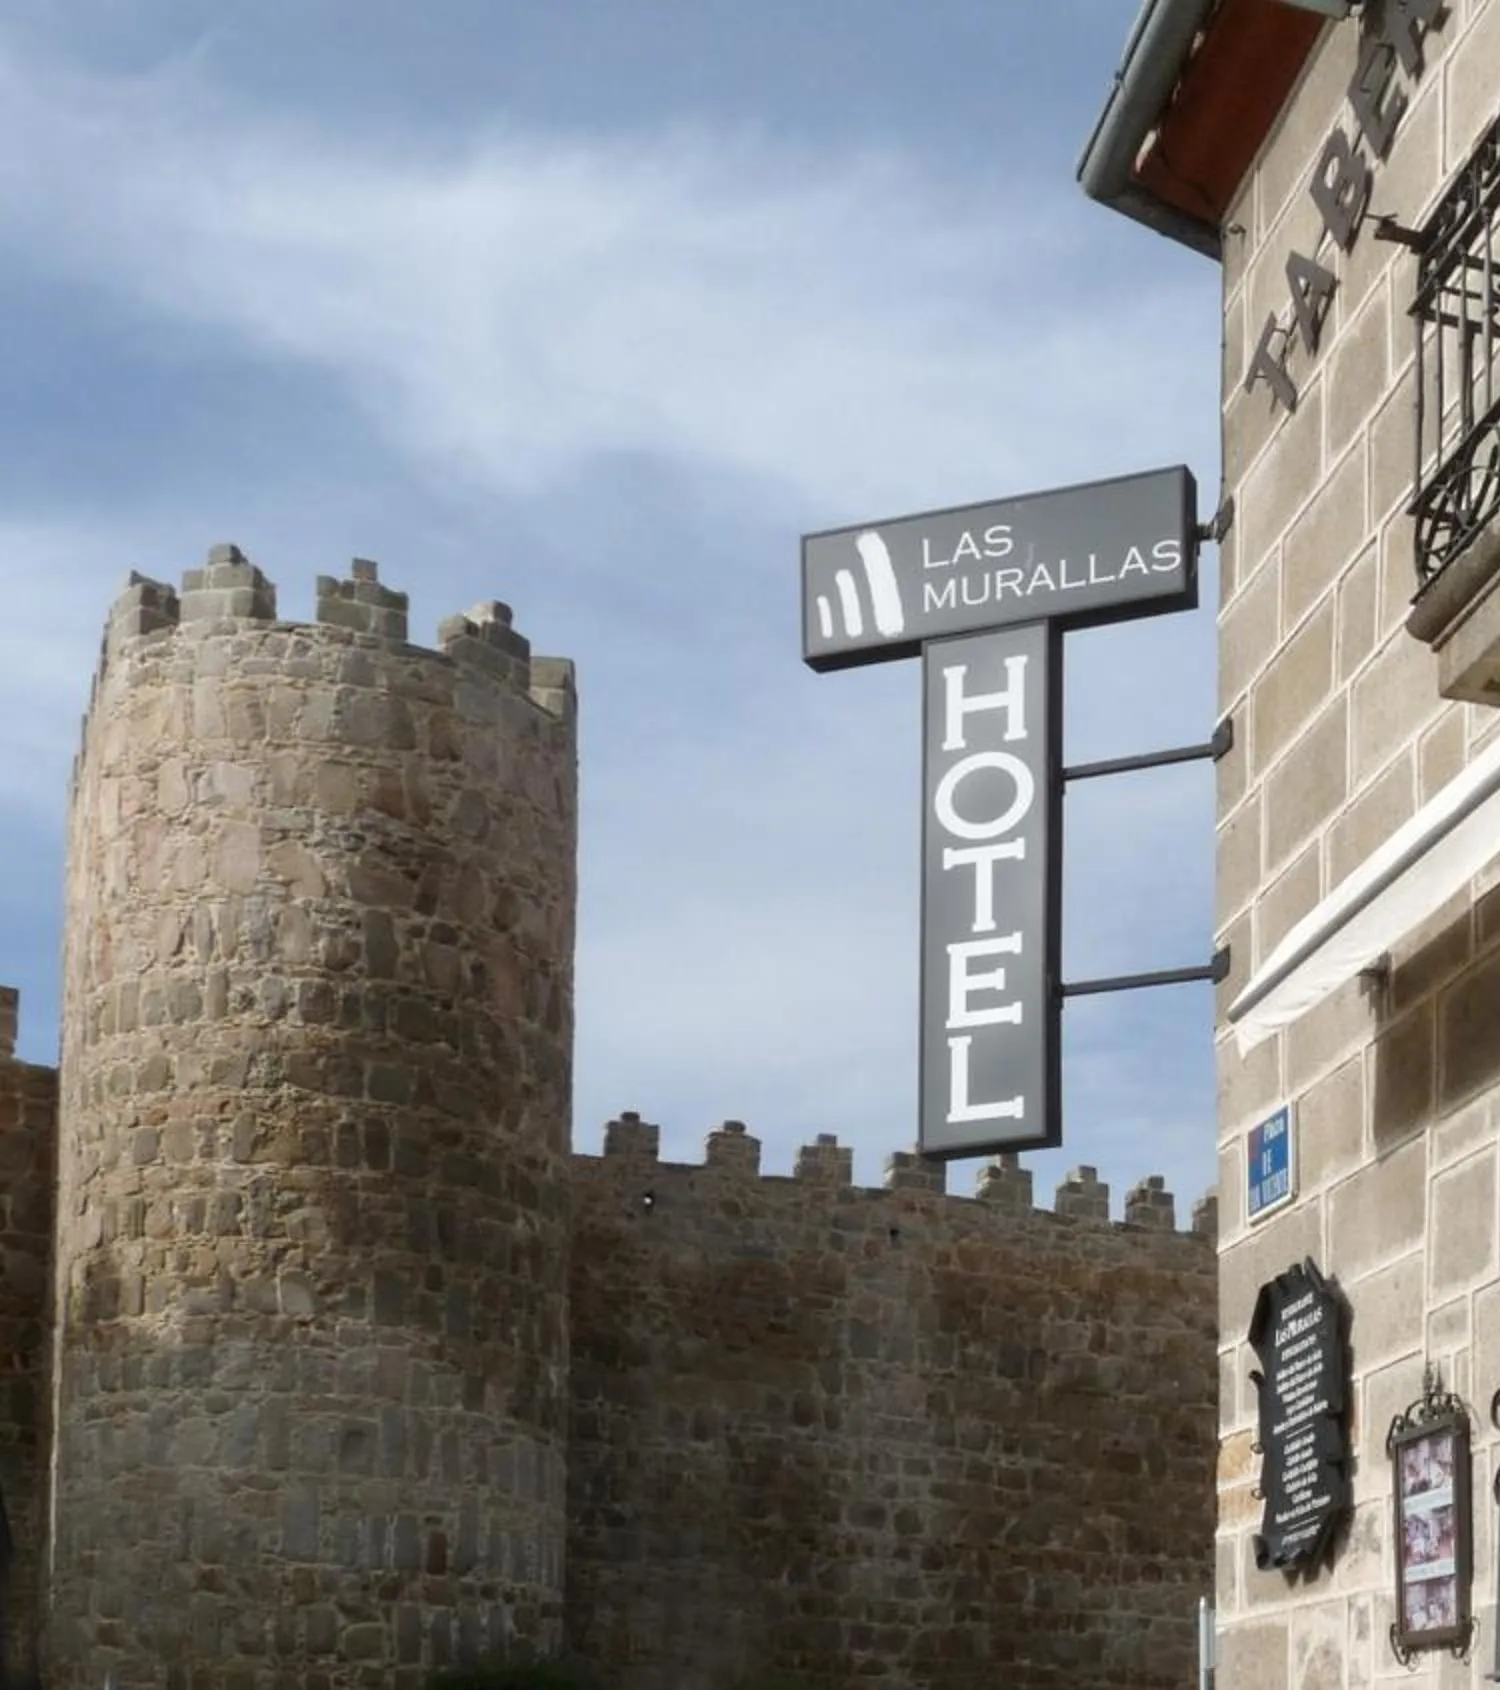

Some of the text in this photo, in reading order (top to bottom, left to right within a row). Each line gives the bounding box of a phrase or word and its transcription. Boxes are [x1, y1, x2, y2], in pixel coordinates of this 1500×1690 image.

[922, 525, 1013, 568] LAS
[923, 539, 1182, 613] MURALLAS
[935, 655, 1034, 1123] HOTEL
